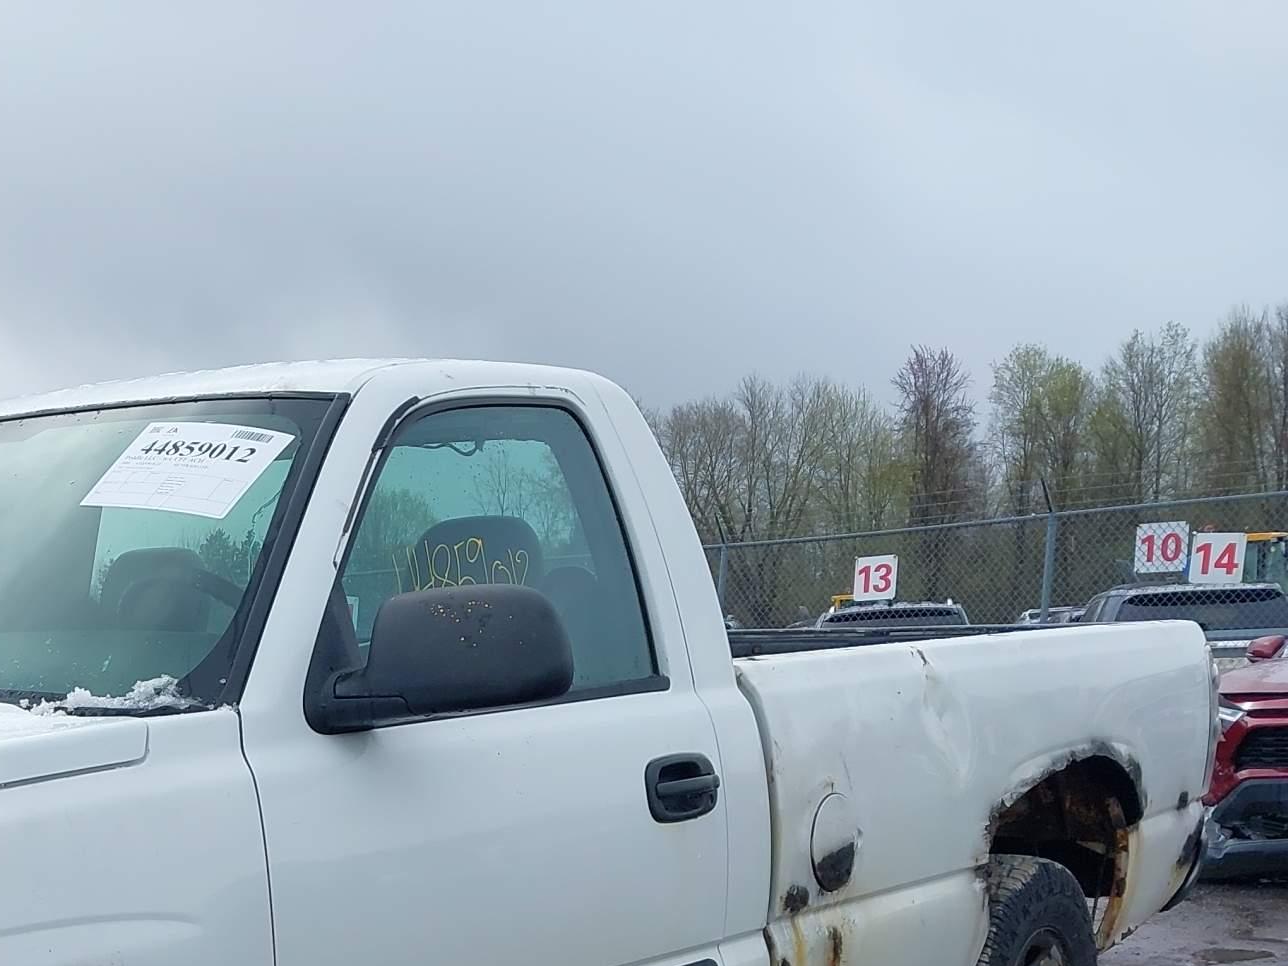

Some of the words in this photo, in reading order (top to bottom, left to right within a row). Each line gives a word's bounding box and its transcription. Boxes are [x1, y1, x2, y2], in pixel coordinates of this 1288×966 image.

[141, 440, 257, 463] 44859012
[1141, 532, 1182, 563] 10
[1195, 542, 1239, 575] 14
[858, 563, 893, 593] 13
